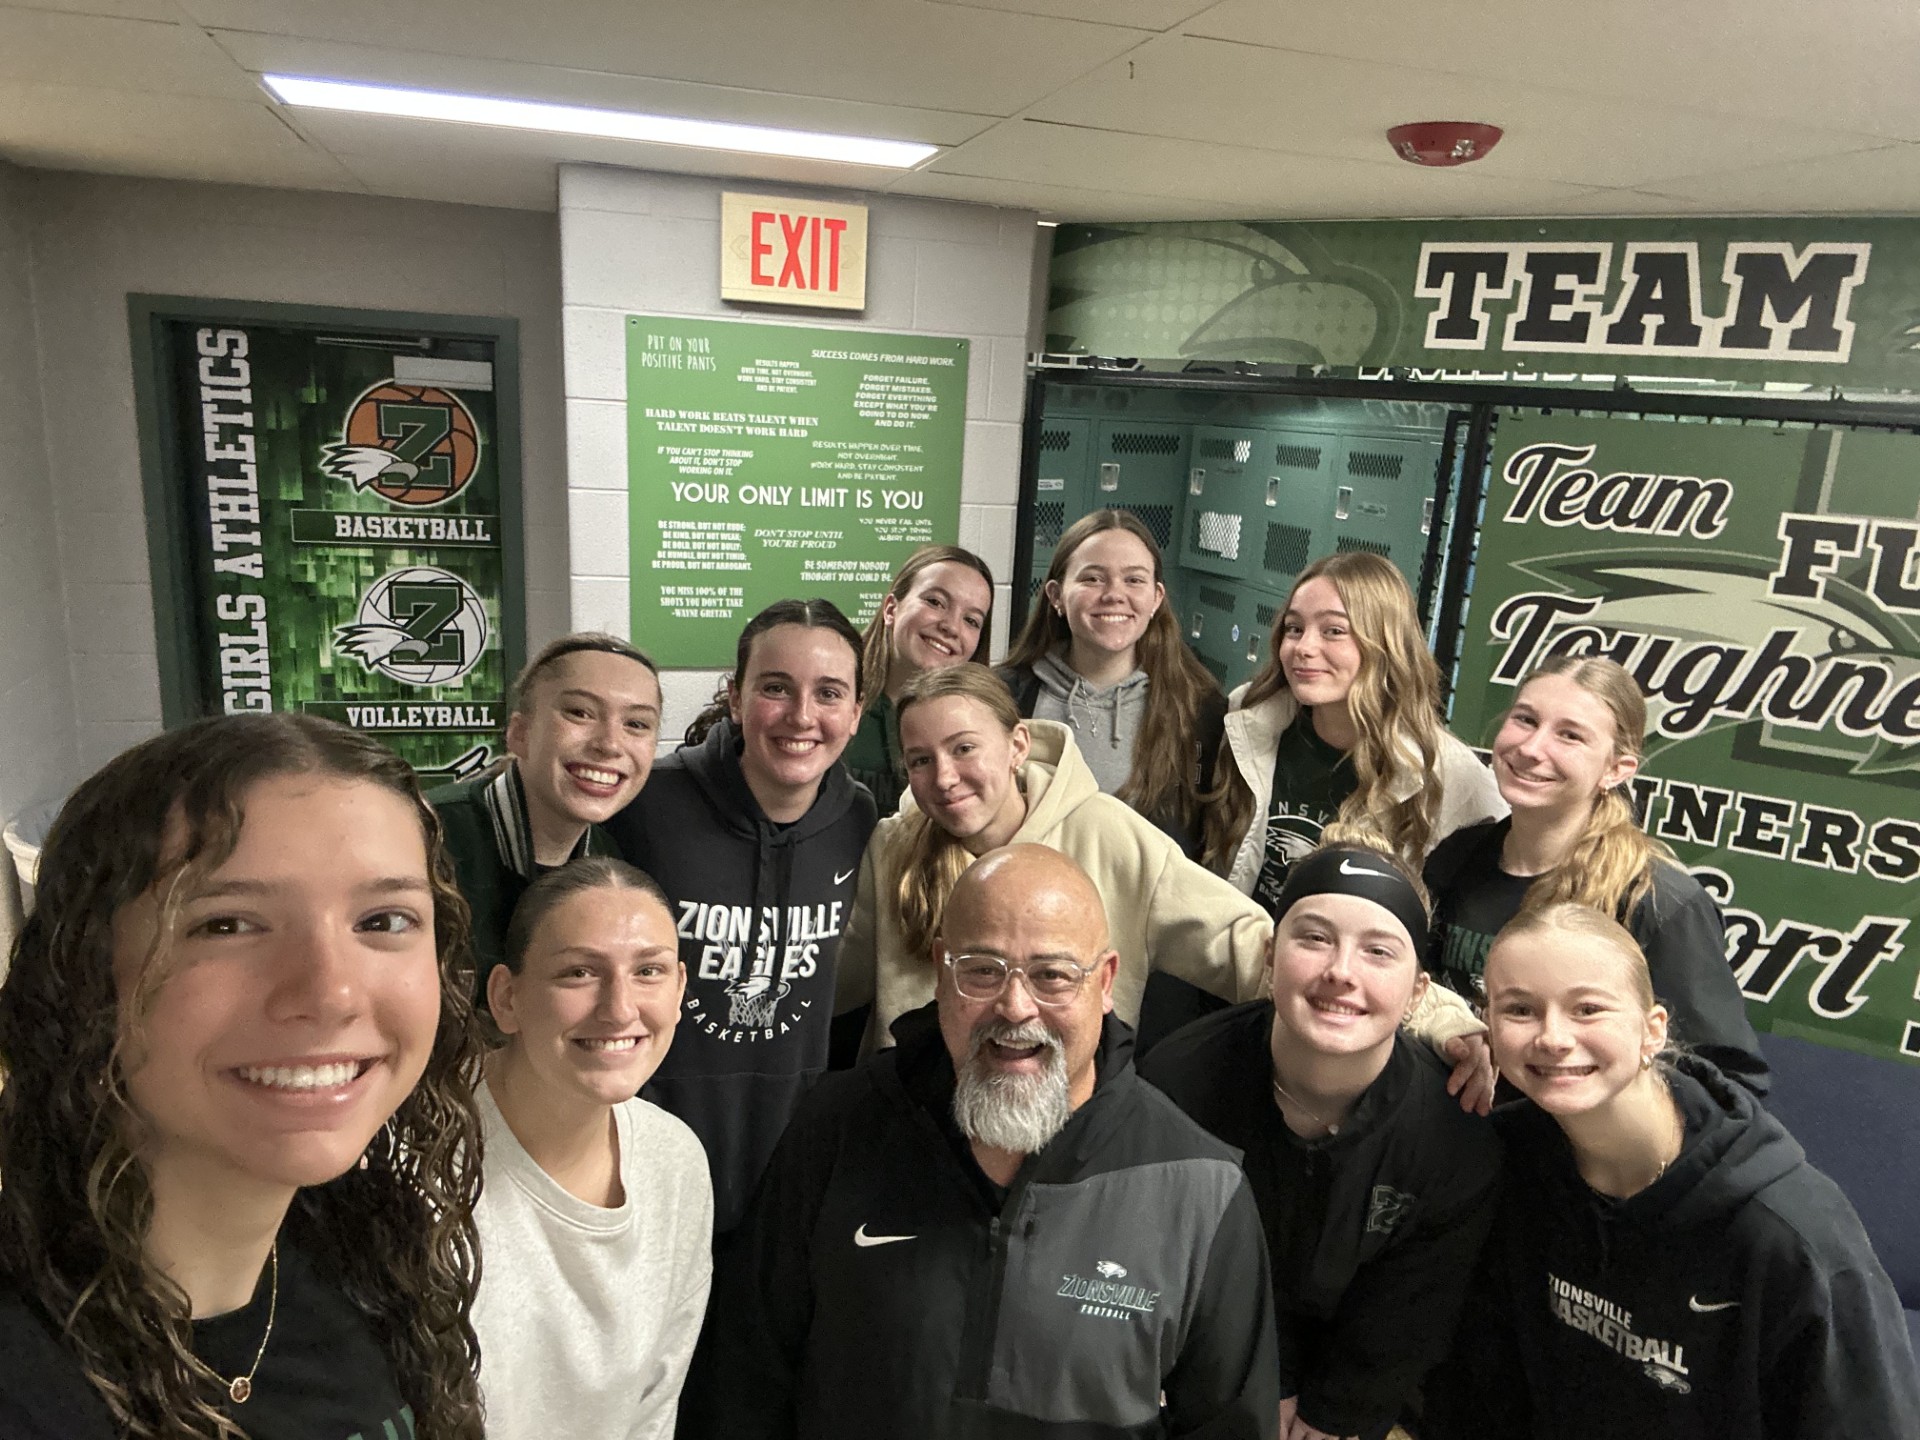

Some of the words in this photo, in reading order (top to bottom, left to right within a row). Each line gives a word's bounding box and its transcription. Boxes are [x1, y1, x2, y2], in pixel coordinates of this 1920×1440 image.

[751, 212, 847, 291] EXIT
[1414, 240, 1873, 364] TEAM
[648, 335, 665, 350] PUT
[670, 337, 681, 351] ON
[687, 338, 710, 353] YOUR
[642, 352, 682, 370] POSITIVE
[688, 355, 716, 371] PANTS
[811, 350, 847, 359] SUCCESS
[850, 352, 878, 362] COMES
[880, 354, 904, 363] FROM
[906, 355, 928, 365] HARD
[929, 357, 955, 366] WORK.
[864, 375, 894, 383] FORGET
[895, 376, 930, 384] FAILURE.
[860, 384, 891, 392] FORGET
[892, 385, 933, 394] MISTAKES.
[856, 392, 886, 400] FORGET
[888, 394, 937, 402] EVERYTHING
[854, 401, 885, 409] EXCEPT
[886, 402, 908, 410] WHAT
[910, 403, 937, 411] YOU'RE
[646, 408, 675, 419] HARD
[678, 410, 710, 420] WORK
[713, 413, 746, 422] BEATS
[748, 414, 786, 425] TALENT
[789, 416, 819, 426] WHEN
[859, 410, 885, 418] GOING
[894, 420, 904, 428] DO
[657, 422, 697, 432] TALENT
[700, 424, 743, 435] DOESN'T
[746, 426, 776, 436] WORK
[779, 427, 808, 437] HARD
[812, 441, 846, 449] RESULTS
[848, 442, 878, 450] HAPPEN
[196, 328, 264, 579] ATHLETICS
[666, 447, 680, 455] YOU
[682, 448, 702, 456] CAN'T
[722, 450, 753, 458] THINKING
[669, 456, 692, 464] ABOUT
[703, 458, 724, 466] DON'T
[679, 466, 712, 475] WORKING
[878, 464, 924, 472] CONSISTENT
[671, 482, 729, 503] YOUR
[739, 485, 792, 506] ONLY
[801, 487, 848, 507] LIMIT
[856, 489, 872, 508] IS
[882, 490, 923, 509] YOU
[1502, 443, 1734, 540] Team
[334, 514, 491, 541] BASKETBALL
[658, 521, 668, 529] BE
[698, 522, 711, 530] BUT
[713, 522, 726, 530] NOT
[663, 531, 671, 539] BE
[692, 532, 705, 540] BUT
[706, 532, 719, 540] NOT
[754, 529, 786, 537] DON'T
[787, 530, 813, 538] STOP
[814, 531, 844, 539] UNTIL
[693, 542, 705, 550] BUT
[707, 542, 719, 550] NOT
[763, 539, 798, 548] YOU'RE
[711, 552, 724, 560] NOT
[652, 560, 661, 568] BE
[805, 560, 815, 569] BE
[816, 561, 857, 570] SOMEBODY
[860, 562, 889, 570] NOBODY
[800, 572, 836, 581] THOUGHT
[838, 573, 854, 581] YOU
[856, 573, 879, 581] COULD
[661, 586, 675, 595] YOU
[678, 587, 694, 595] MISS
[696, 587, 716, 595] 100%
[718, 587, 727, 596] OF
[729, 587, 743, 596] THE
[661, 597, 683, 606] SHOTS
[685, 598, 699, 607] YOU
[701, 598, 723, 607] DON'T
[725, 599, 743, 607] TAKE
[700, 609, 733, 618] GRETZKY
[216, 594, 272, 715] GIRLS
[346, 706, 495, 728] VOLLEYBALL
[687, 997, 812, 1043] BASKETBALL
[1057, 1273, 1161, 1312] ZIONSVILLE
[1081, 1304, 1131, 1320] FOOTBALL
